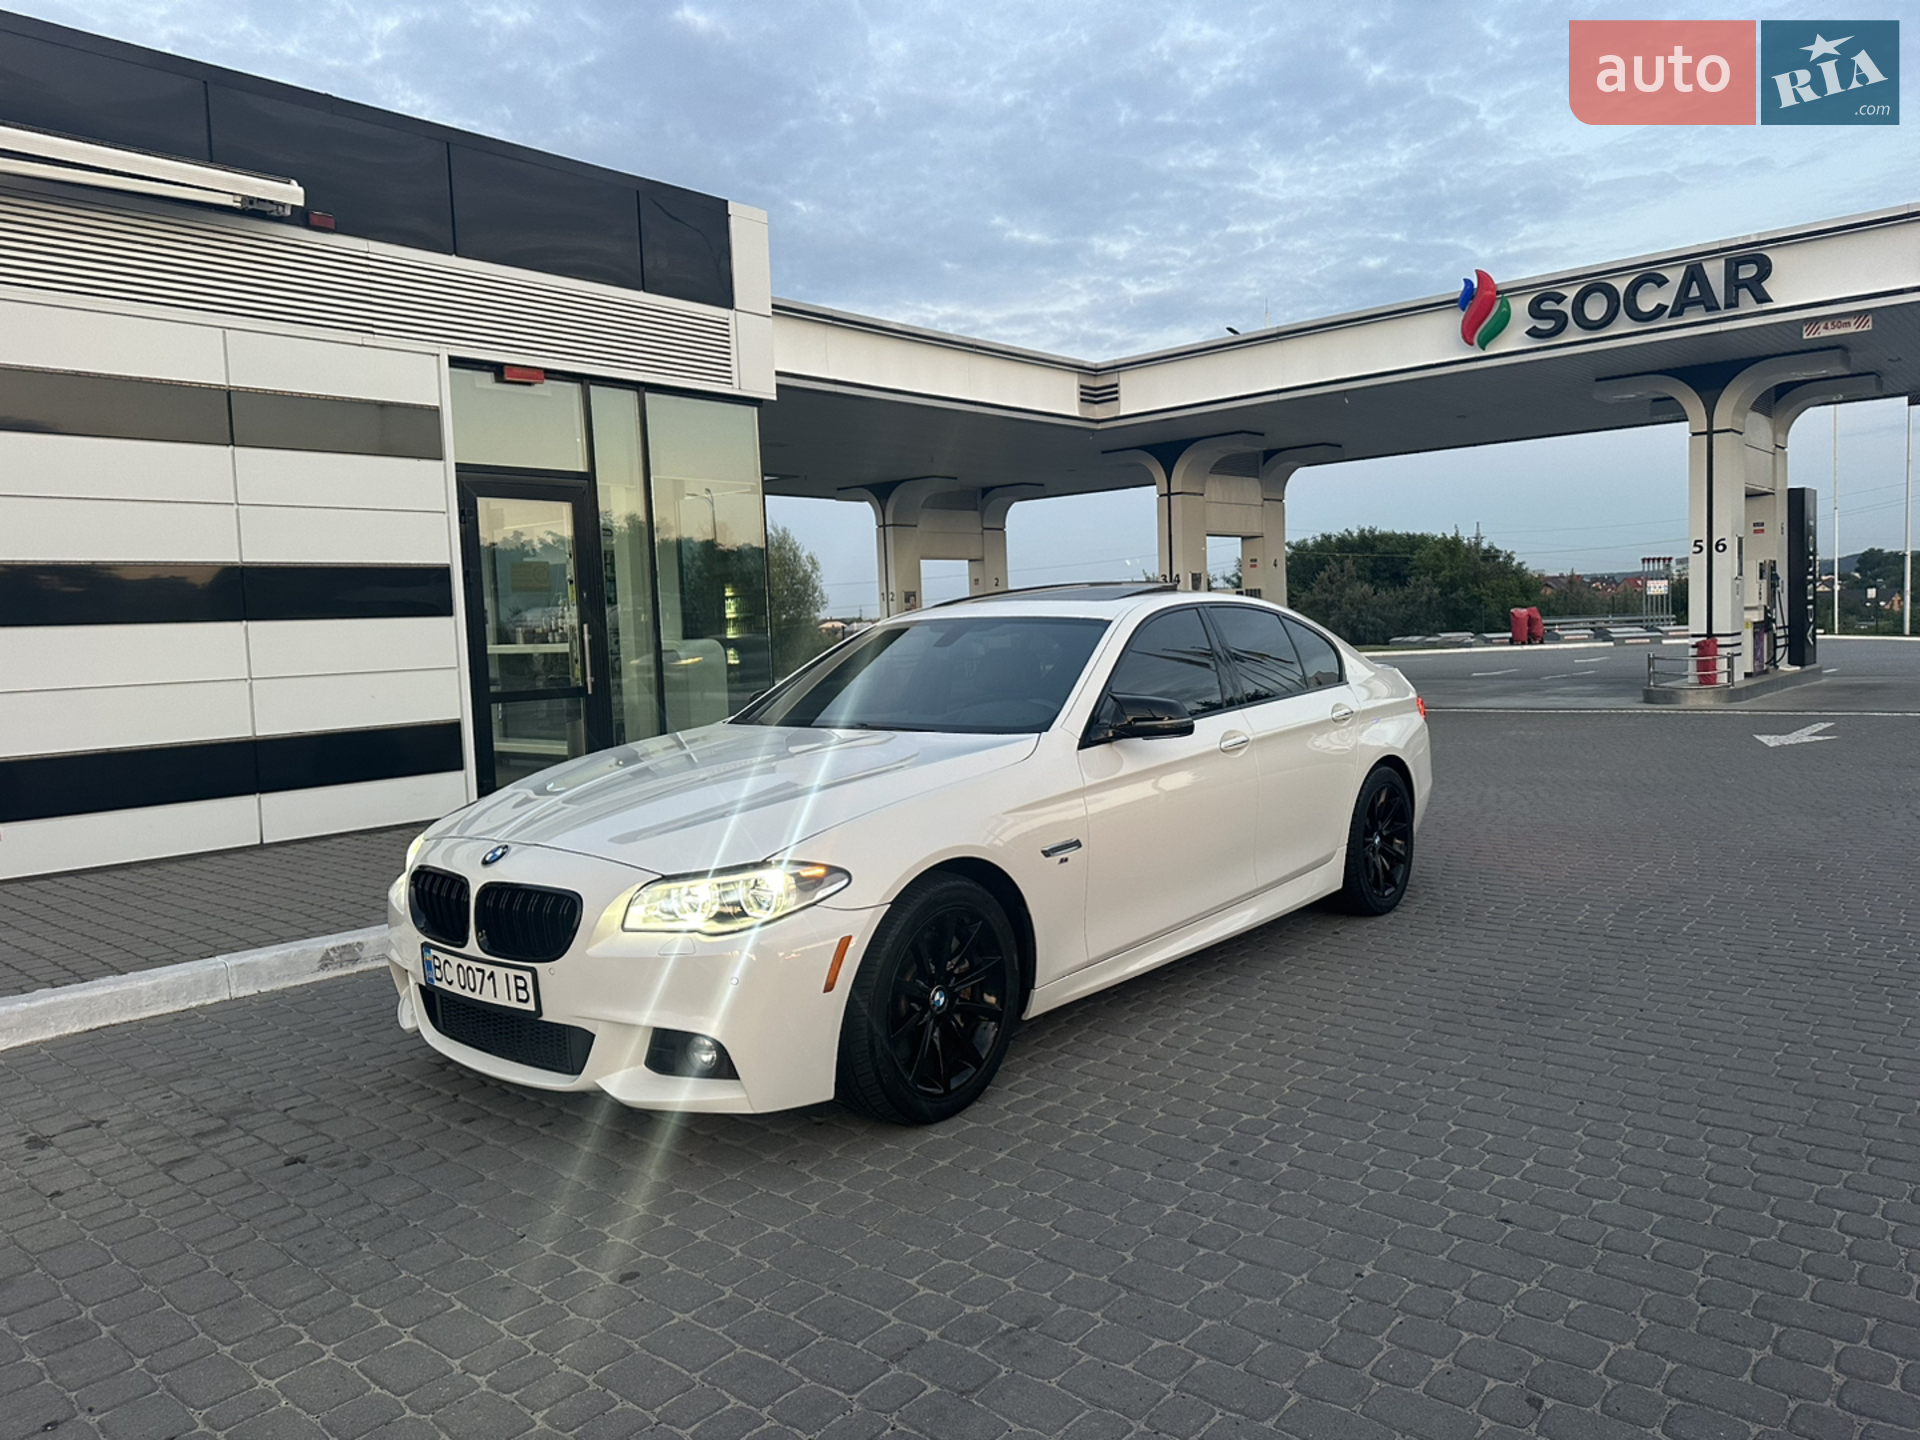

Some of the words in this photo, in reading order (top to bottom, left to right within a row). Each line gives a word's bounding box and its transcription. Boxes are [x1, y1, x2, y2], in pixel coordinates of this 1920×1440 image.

[1525, 253, 1773, 338] SOCAR
[1692, 539, 1704, 554] 5
[1714, 538, 1727, 553] 6
[433, 955, 454, 986] BC
[456, 963, 497, 998] 0071
[505, 972, 530, 1004] IB
